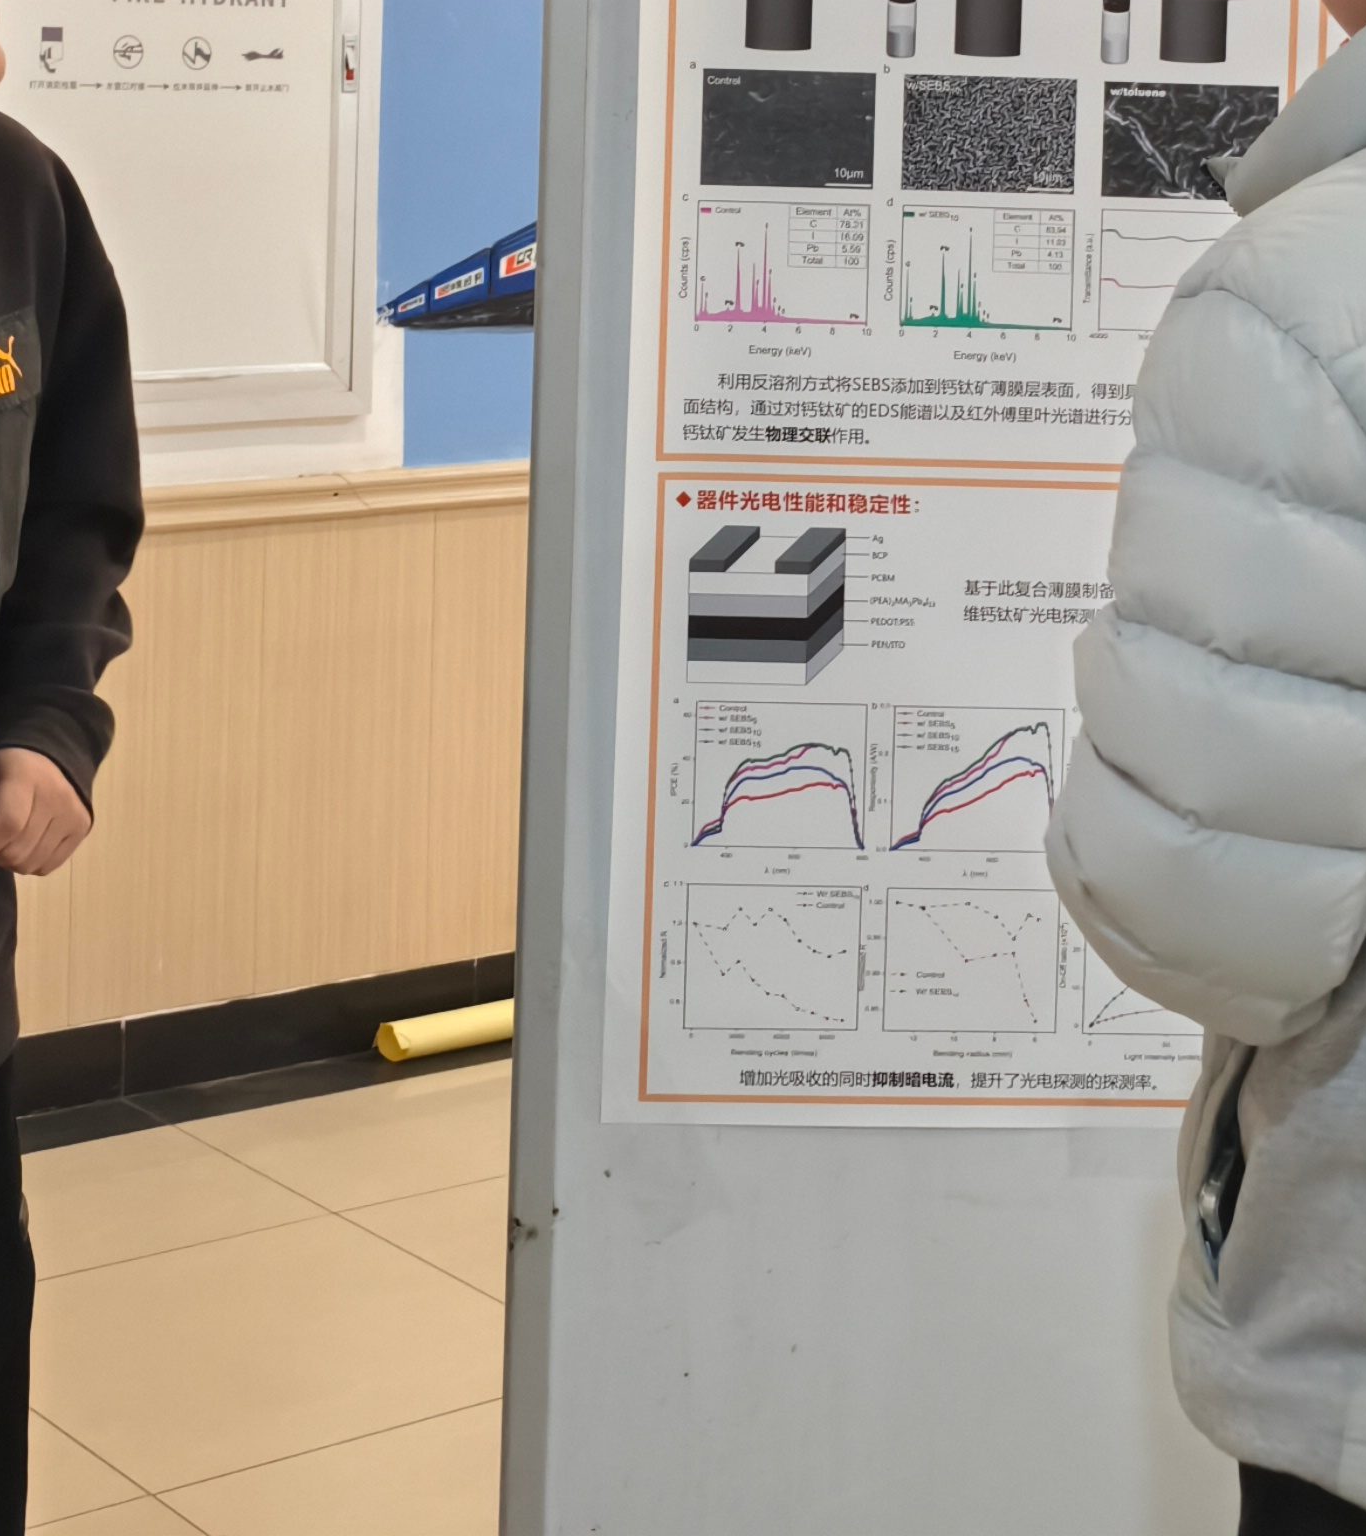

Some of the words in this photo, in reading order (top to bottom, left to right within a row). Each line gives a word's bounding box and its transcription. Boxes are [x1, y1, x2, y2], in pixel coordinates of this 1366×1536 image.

[707, 76, 741, 85] Control
[795, 207, 832, 218] Element
[678, 262, 687, 298] Counts
[884, 265, 894, 301] Counts
[748, 346, 783, 357] Energy
[953, 351, 987, 362] Energy
[872, 535, 883, 544] Ag
[964, 580, 1114, 600] 基于此复合薄膜制备
